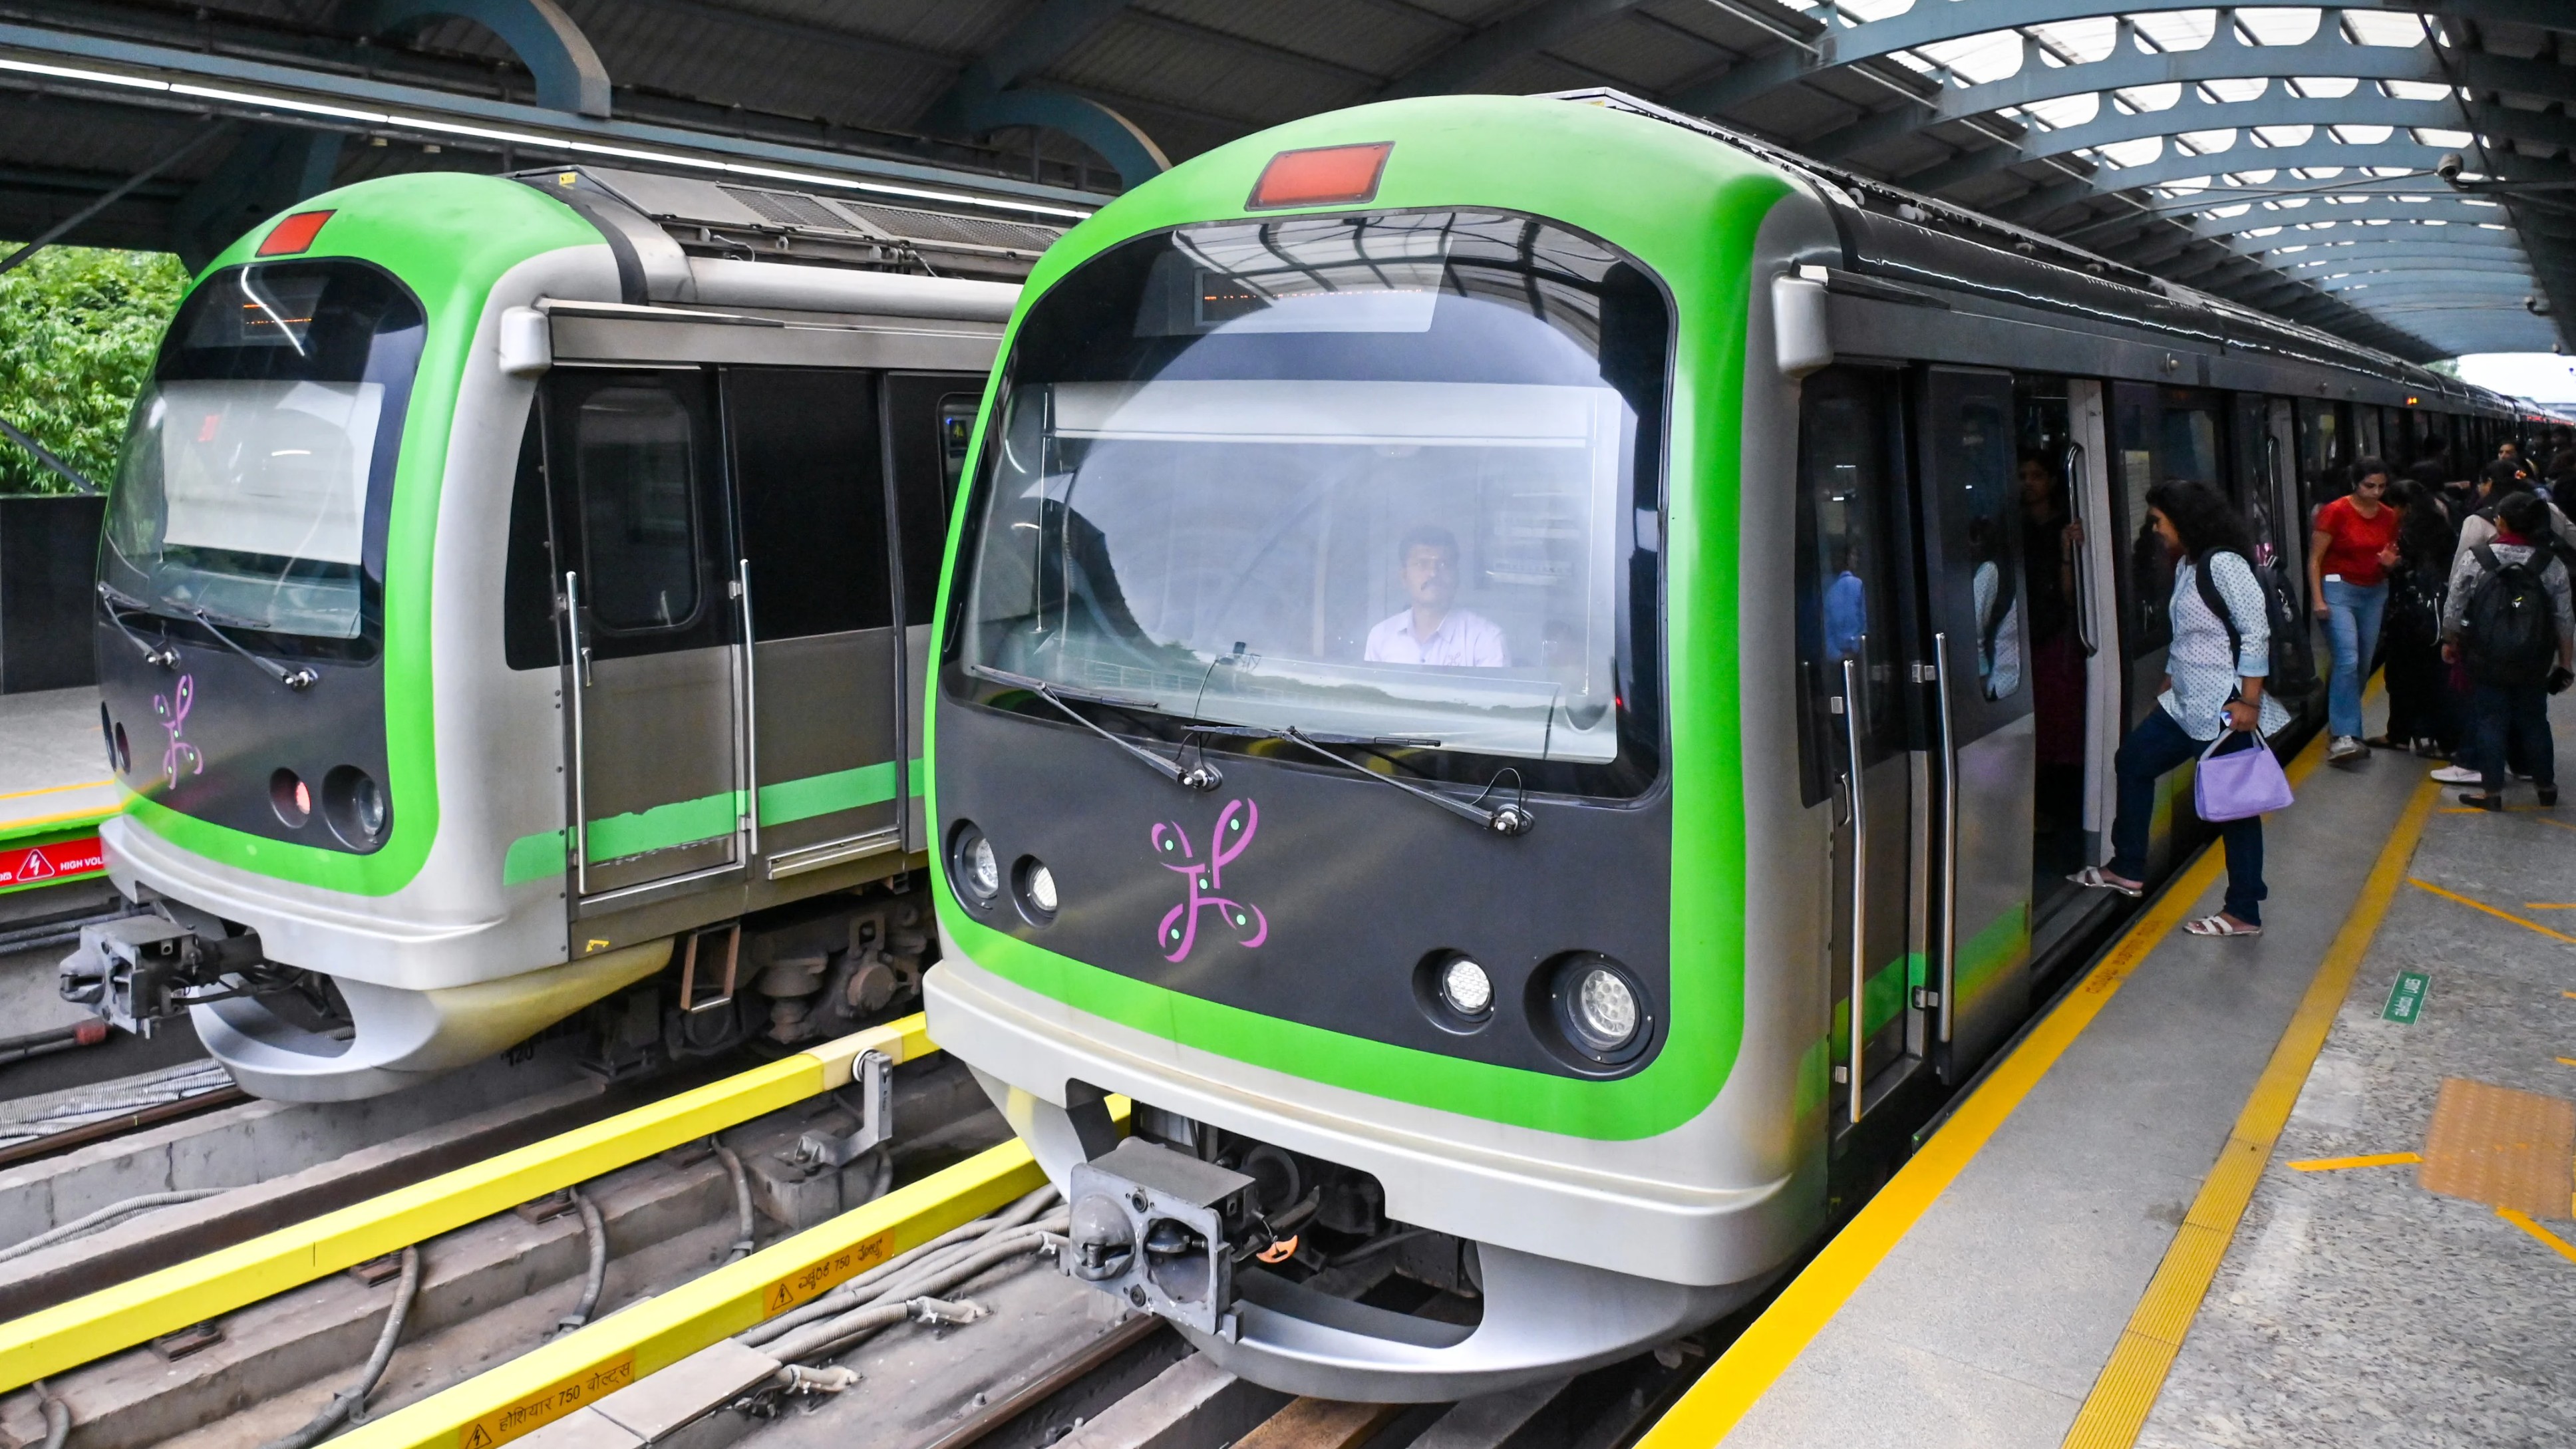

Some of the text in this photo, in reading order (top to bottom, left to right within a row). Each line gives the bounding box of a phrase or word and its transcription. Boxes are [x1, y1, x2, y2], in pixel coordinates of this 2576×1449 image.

[60, 860, 83, 871] HIGH
[834, 1254, 850, 1272] 750
[499, 1394, 556, 1432] होशियार
[559, 1384, 580, 1406] 750
